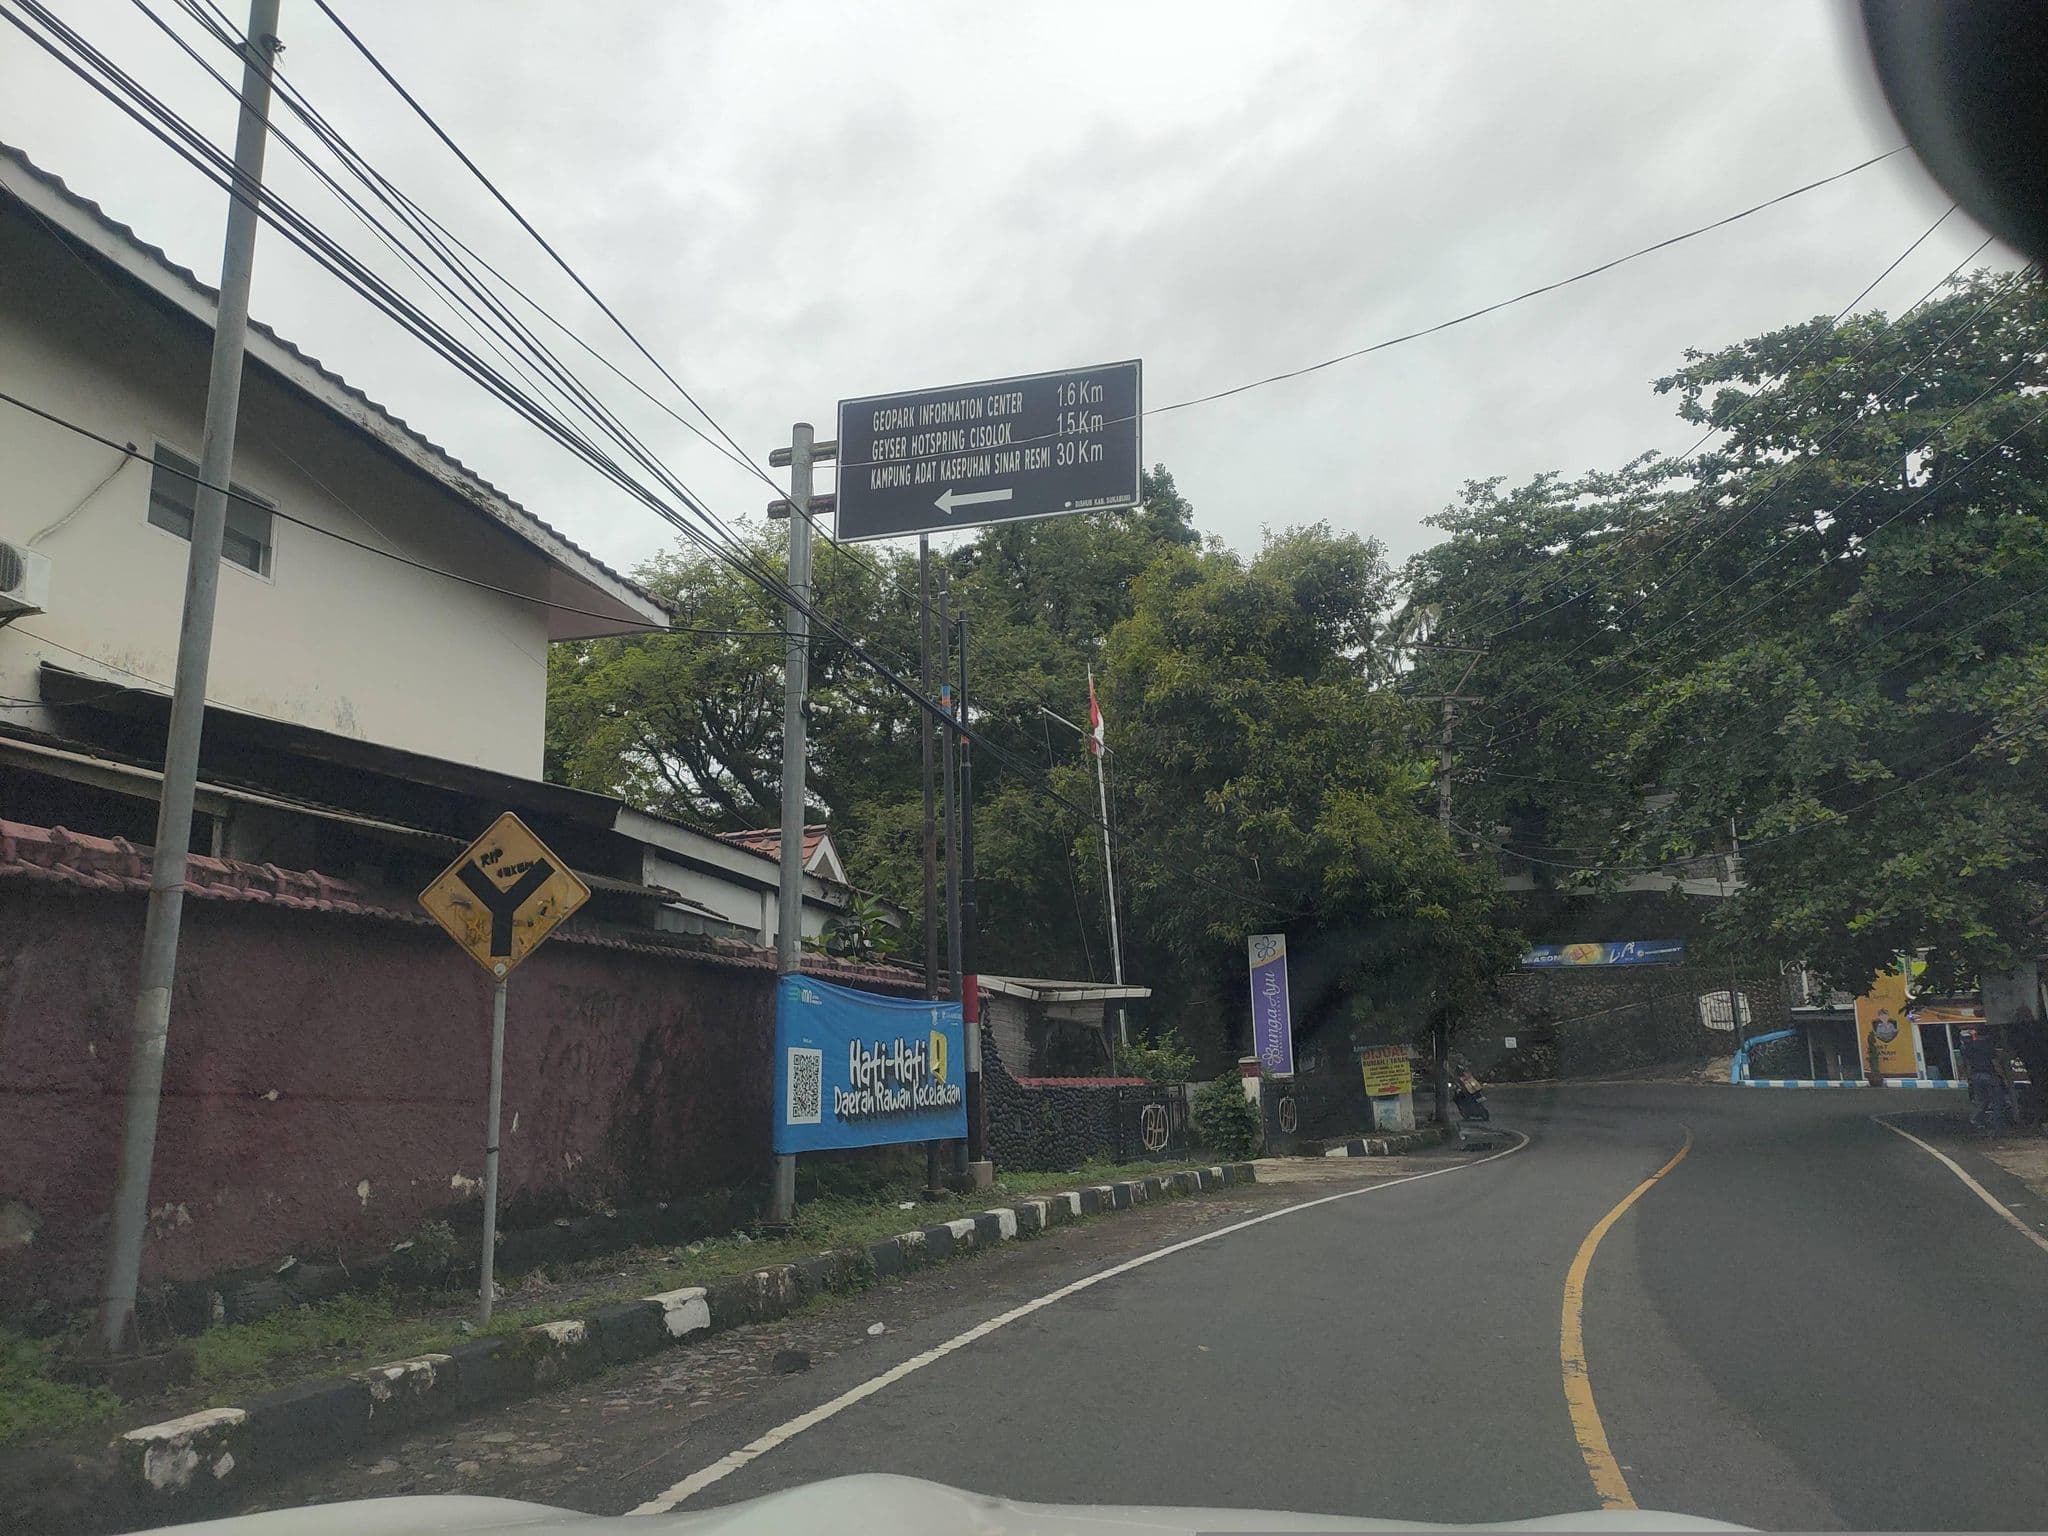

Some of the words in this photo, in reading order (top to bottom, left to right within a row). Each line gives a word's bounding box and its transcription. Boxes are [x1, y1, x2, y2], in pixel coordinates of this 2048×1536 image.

[1057, 383, 1076, 406] 1.6
[1079, 381, 1104, 404] Km
[873, 406, 915, 432] GEOPARK
[919, 398, 982, 424] INFORMATION
[988, 392, 1023, 415] CENTER
[1078, 412, 1103, 433] Km
[872, 439, 907, 460] GEYSER
[912, 430, 965, 455] HOTSPRING
[970, 423, 1011, 446] CISOLOK
[1057, 443, 1074, 466] 30
[1078, 442, 1103, 463] Km
[870, 465, 911, 490] KAMPUNG
[915, 461, 937, 483] ADAT
[940, 457, 990, 481] KASEPUHAN
[995, 451, 1020, 474] SINAR
[1024, 447, 1050, 470] RESMI
[834, 1086, 874, 1115] Daerah
[876, 1084, 911, 1112] Rawan
[913, 1081, 960, 1110] Kecelakaan
